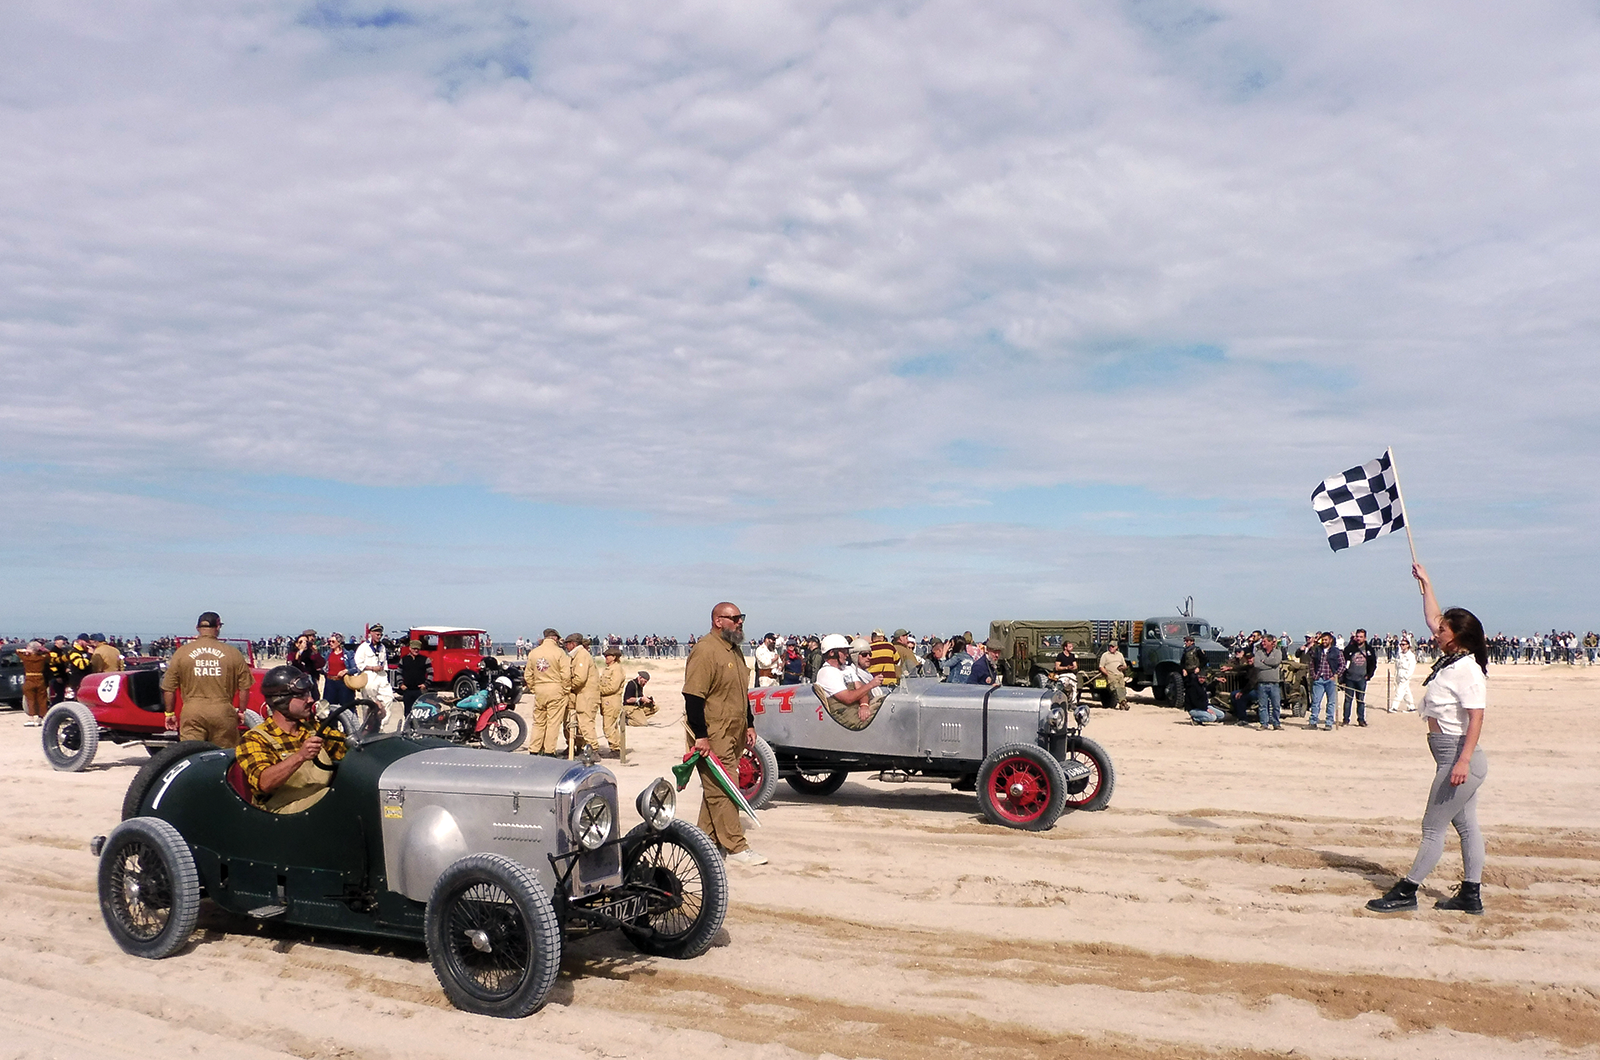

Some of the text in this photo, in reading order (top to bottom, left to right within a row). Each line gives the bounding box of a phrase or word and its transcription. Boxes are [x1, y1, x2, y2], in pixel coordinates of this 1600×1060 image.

[188, 647, 226, 660] NORMANDY
[195, 659, 219, 667] BEACH
[194, 667, 222, 677] RACE
[102, 680, 114, 692] 25
[615, 900, 629, 920] DZ
